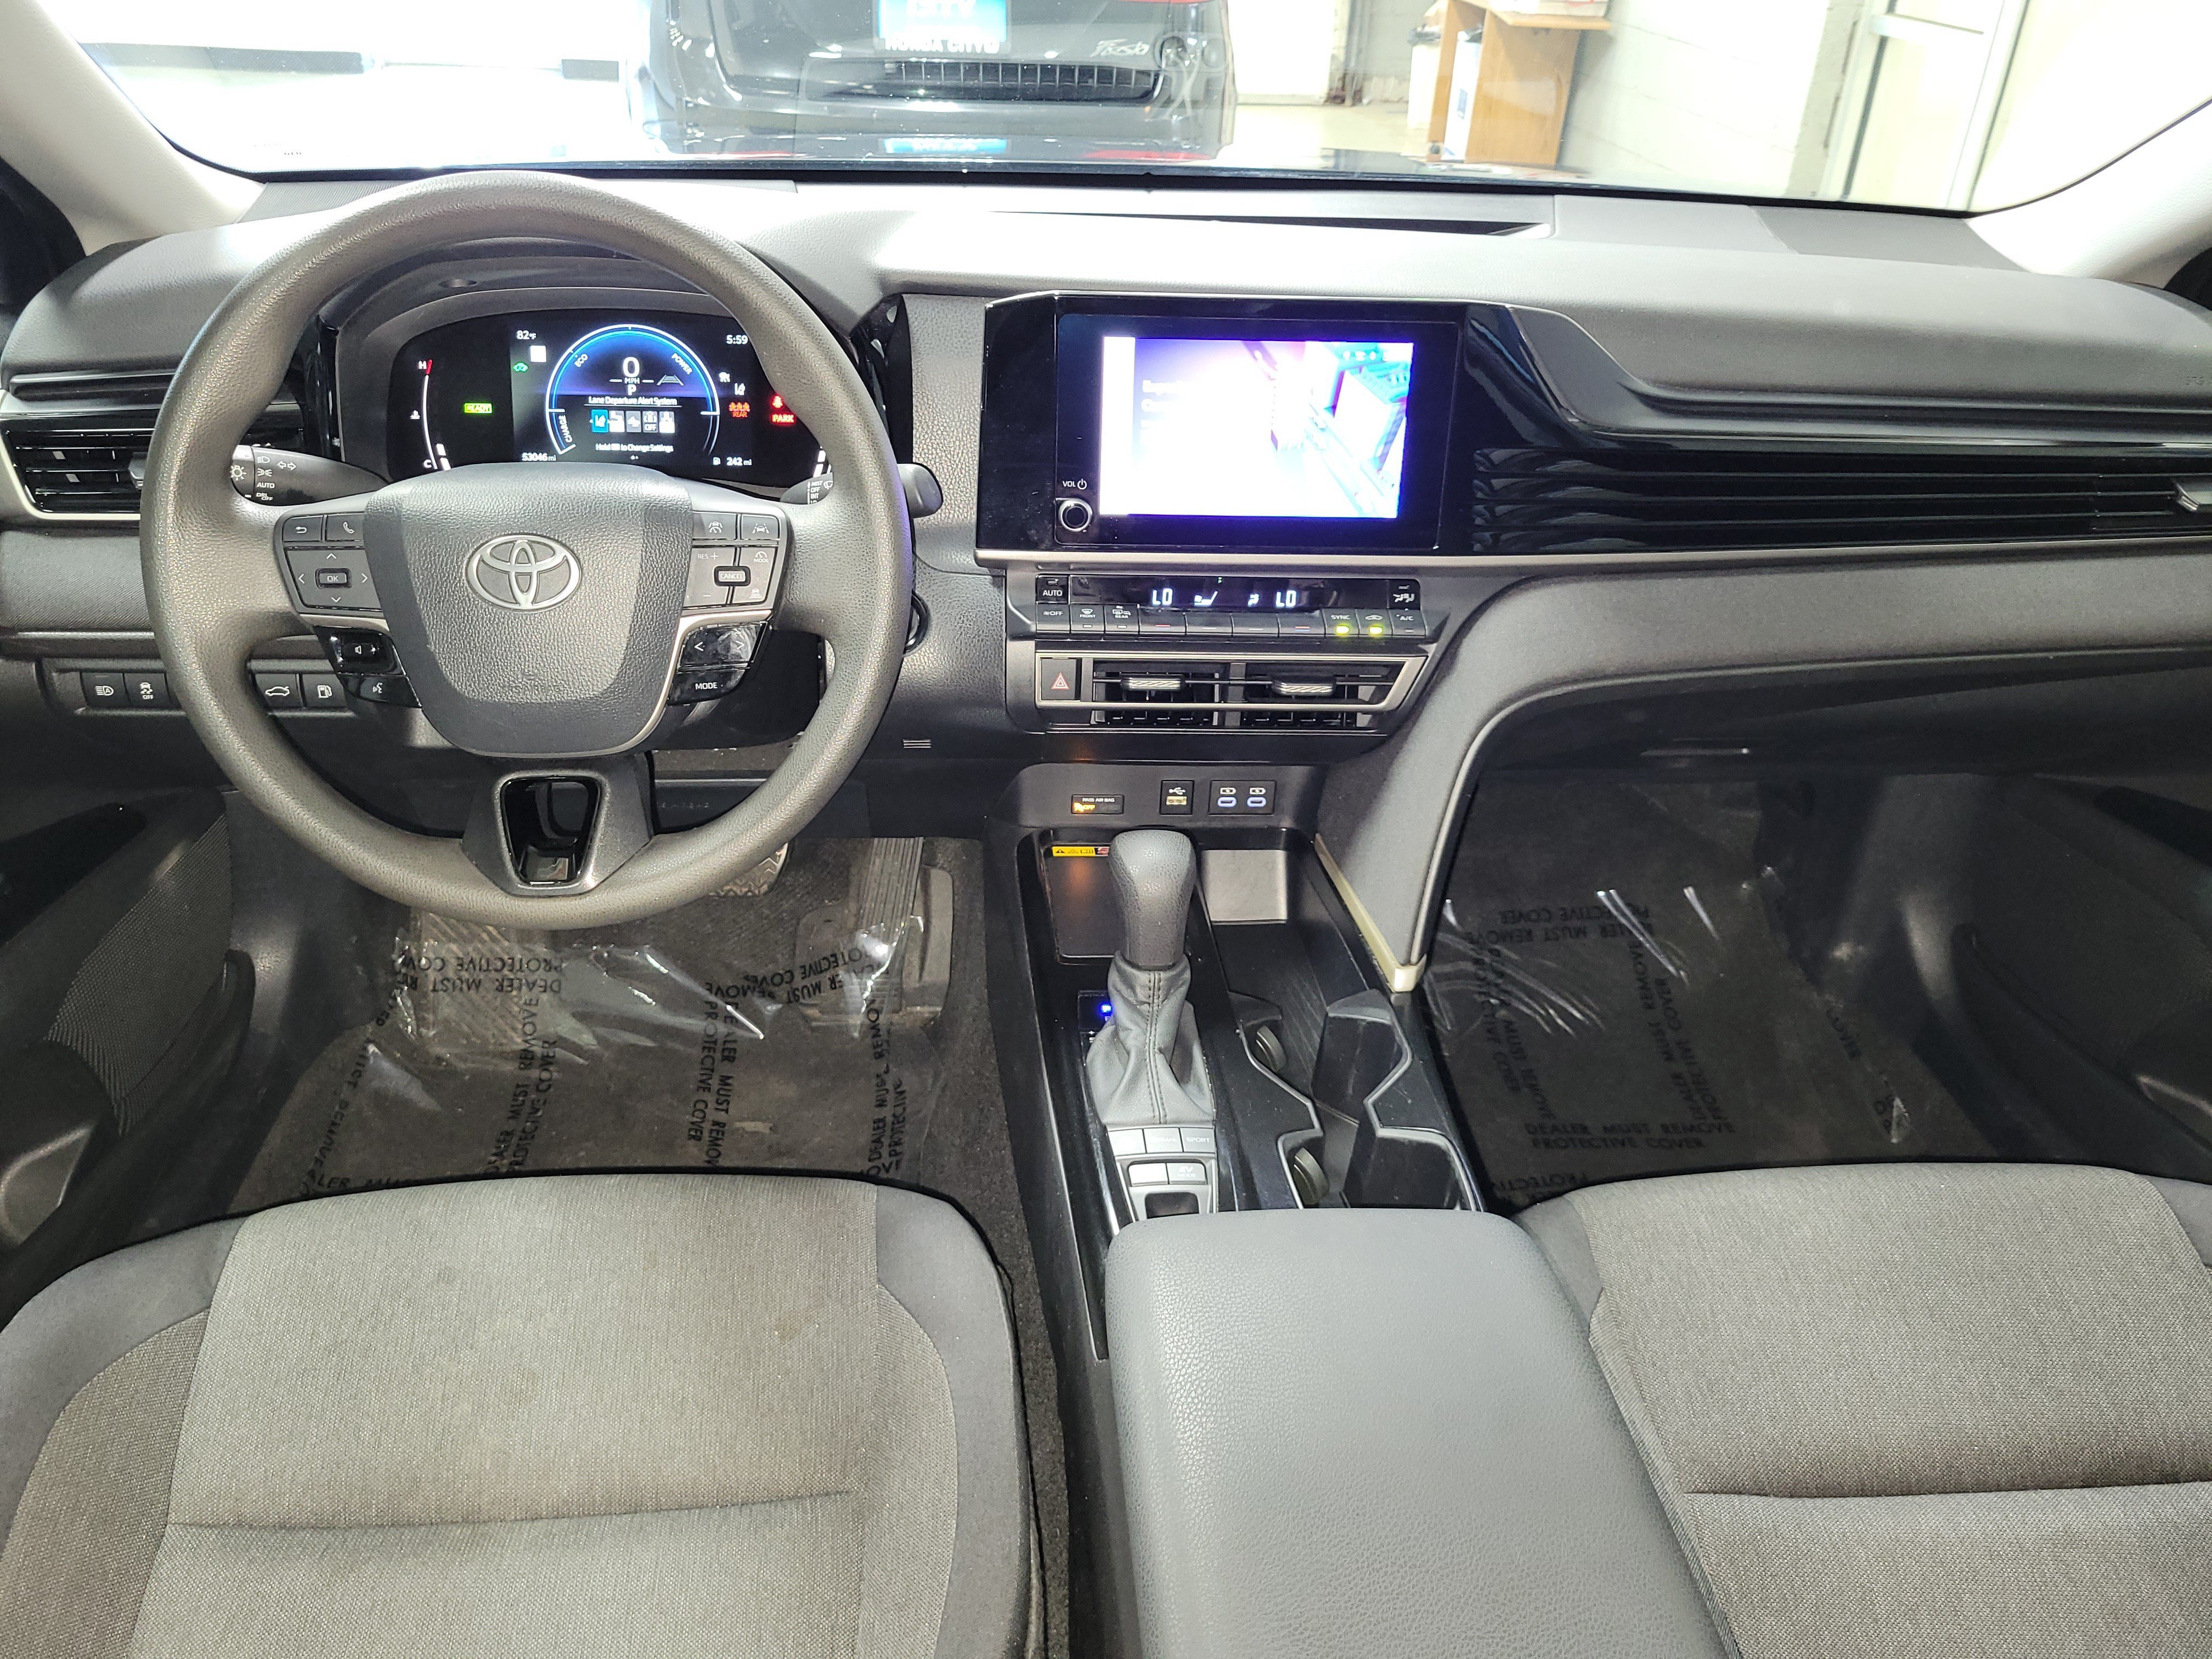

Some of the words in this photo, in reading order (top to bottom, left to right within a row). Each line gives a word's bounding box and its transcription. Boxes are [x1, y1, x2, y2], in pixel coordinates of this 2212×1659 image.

[726, 335, 748, 345] 5:59
[418, 360, 427, 369] H
[574, 353, 588, 368] ECO
[623, 357, 640, 377] 0
[671, 353, 693, 375] POWER
[628, 385, 637, 396] P
[589, 396, 605, 404] Lane
[605, 397, 637, 405] Departure
[653, 397, 678, 407] System
[772, 414, 794, 423] PARK
[558, 415, 573, 443] CHARGE
[424, 459, 432, 468] C
[522, 453, 548, 461] 53046
[726, 457, 742, 466] 242
[695, 682, 718, 690] MODE
[456, 956, 563, 973] PROTECTIVE
[431, 978, 481, 994] MUST
[495, 978, 562, 994] DEALER
[787, 980, 821, 1005] MUST
[518, 997, 538, 1070] REMOVE
[696, 1001, 719, 1092] PROTECTIVE
[536, 1040, 557, 1093] COVER
[714, 1075, 735, 1114] MUST
[687, 1099, 709, 1142] COVER
